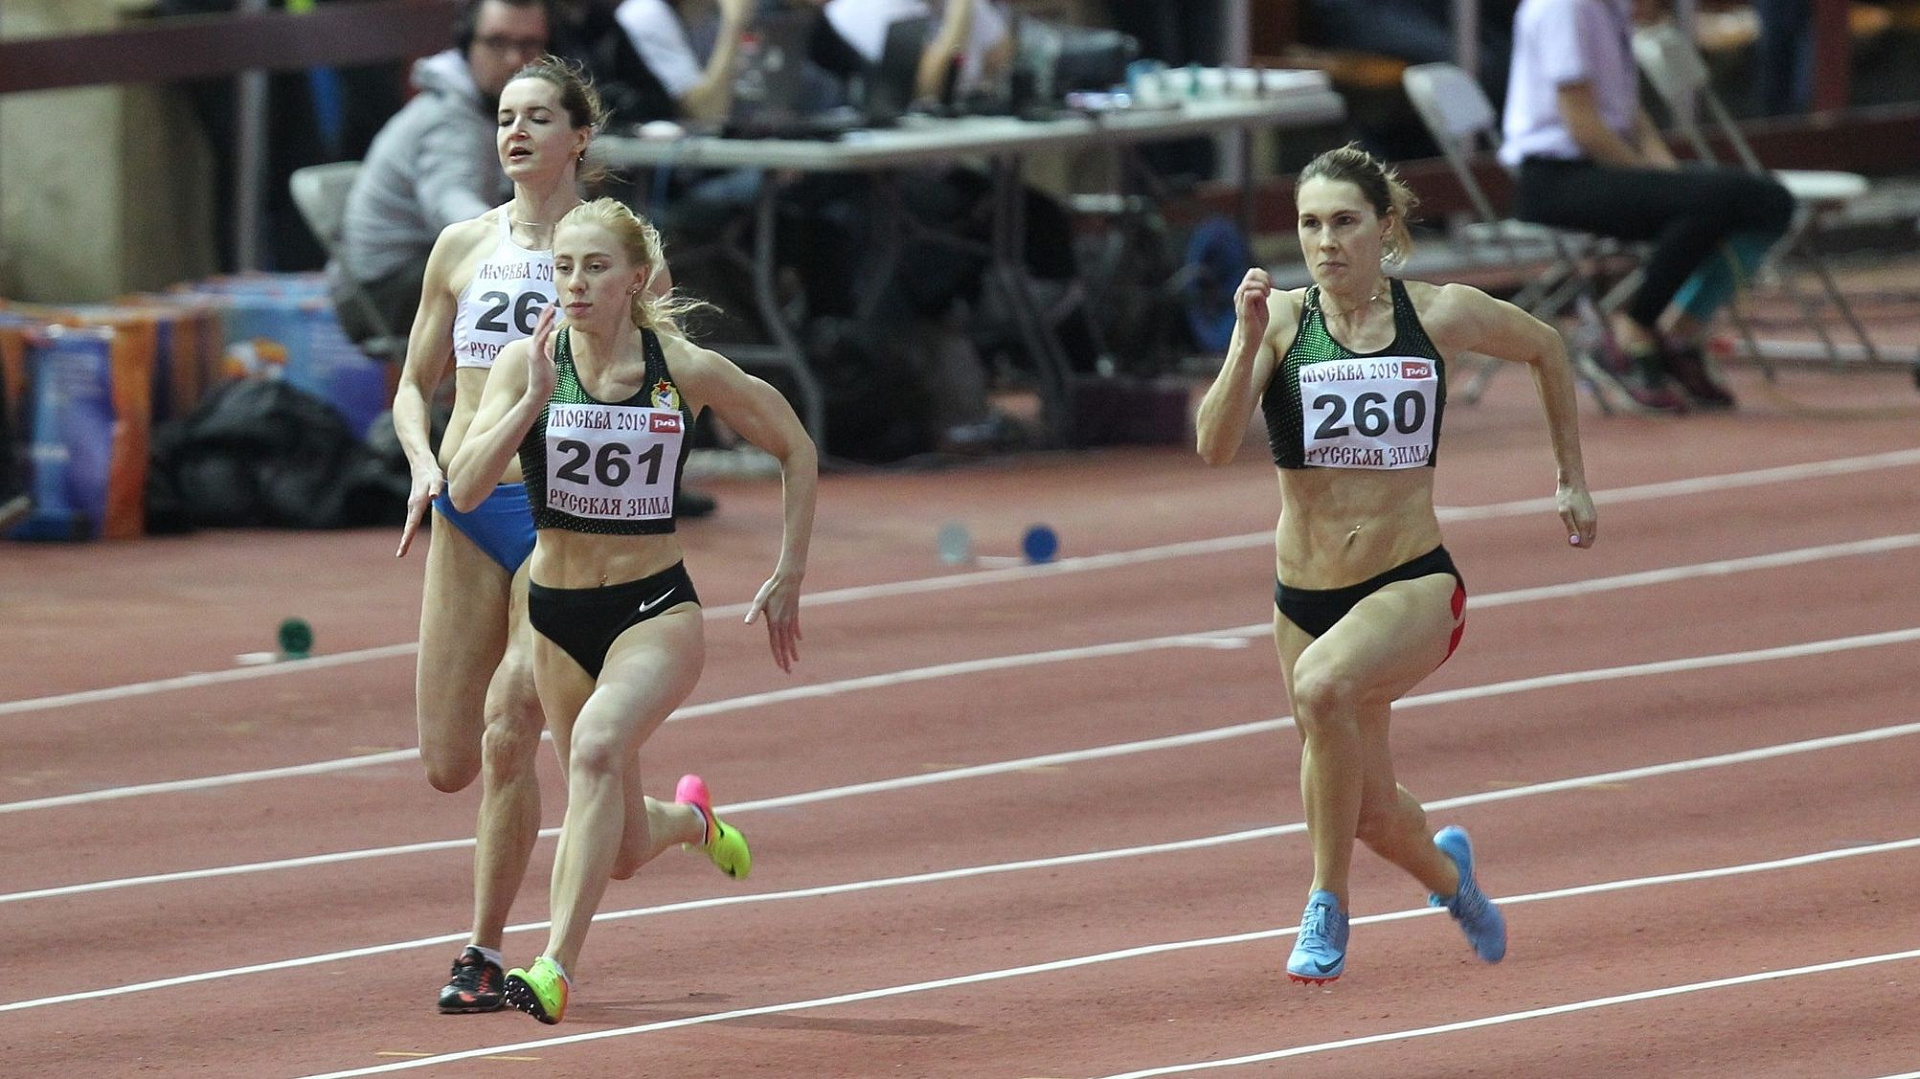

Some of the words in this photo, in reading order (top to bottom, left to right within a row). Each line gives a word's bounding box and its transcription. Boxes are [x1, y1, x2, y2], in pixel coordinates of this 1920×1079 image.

[480, 262, 531, 279] МОСКВА
[536, 263, 554, 282] 201
[475, 291, 560, 335] 26
[1303, 363, 1365, 383] МОСКВА
[1370, 362, 1398, 379] 2019
[551, 409, 612, 430] МОСКВА
[617, 412, 647, 431] 2019
[1313, 390, 1426, 439] 260
[556, 440, 664, 487] 261
[1307, 446, 1384, 466] РУССКАЯ
[1389, 445, 1429, 467] ЗИМА
[549, 488, 622, 515] РУССКАЯ
[627, 496, 670, 517] ЗИМА
